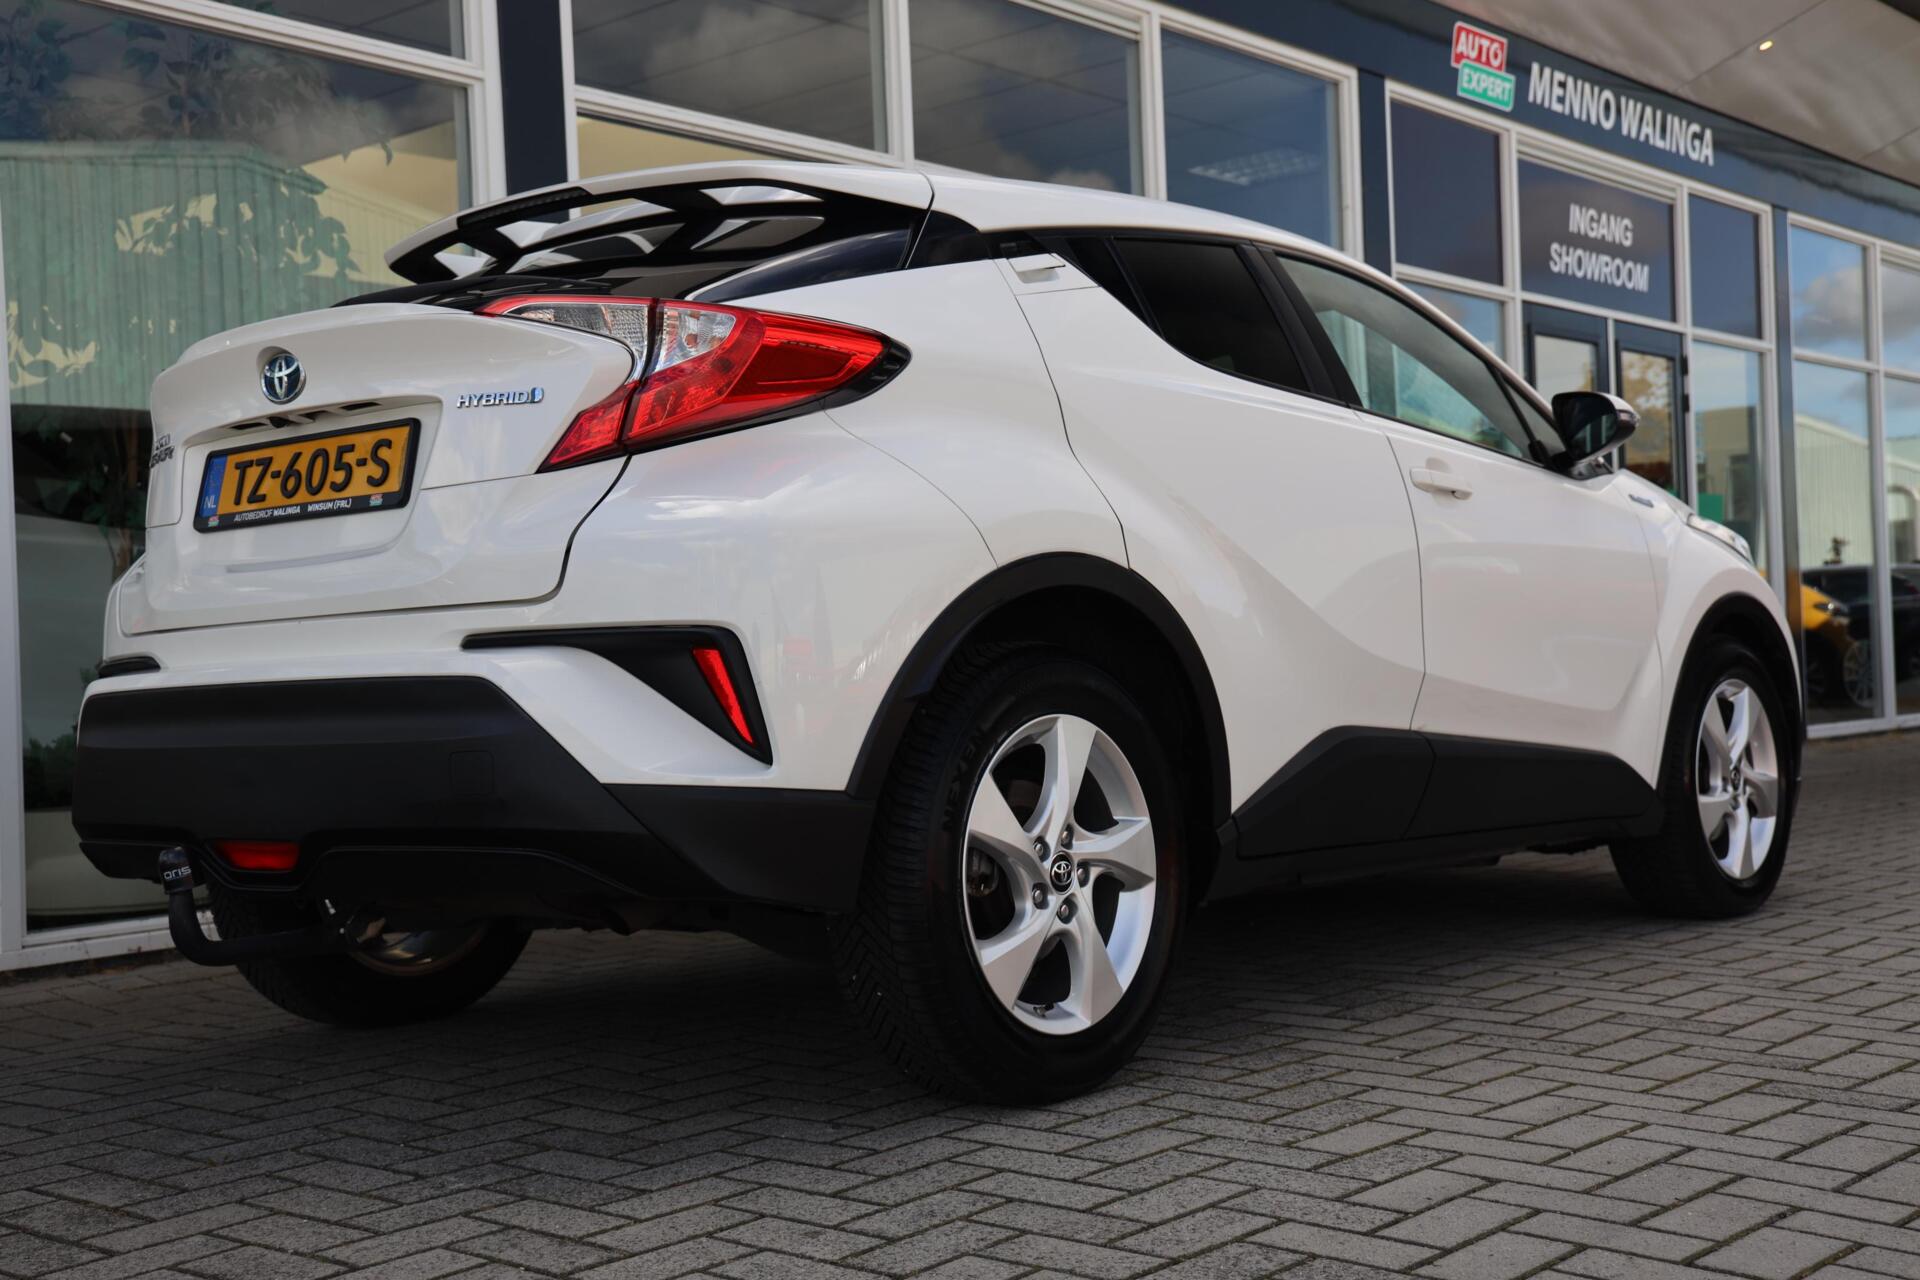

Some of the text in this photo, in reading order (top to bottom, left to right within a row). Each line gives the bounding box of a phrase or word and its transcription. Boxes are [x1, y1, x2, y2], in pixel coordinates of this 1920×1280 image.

[1456, 30, 1503, 67] AUTO
[1461, 67, 1512, 101] EXPERT
[1528, 62, 1714, 166] MENNO WALINGA
[1568, 203, 1634, 247] INGANG
[1549, 242, 1649, 292] SHOWROOM
[456, 390, 529, 408] HYBRID
[233, 438, 393, 506] TZ-605-S
[203, 495, 217, 509] NL
[273, 505, 301, 517] WALINGA
[307, 501, 333, 512] WINSUM
[333, 498, 353, 509] (FRL)
